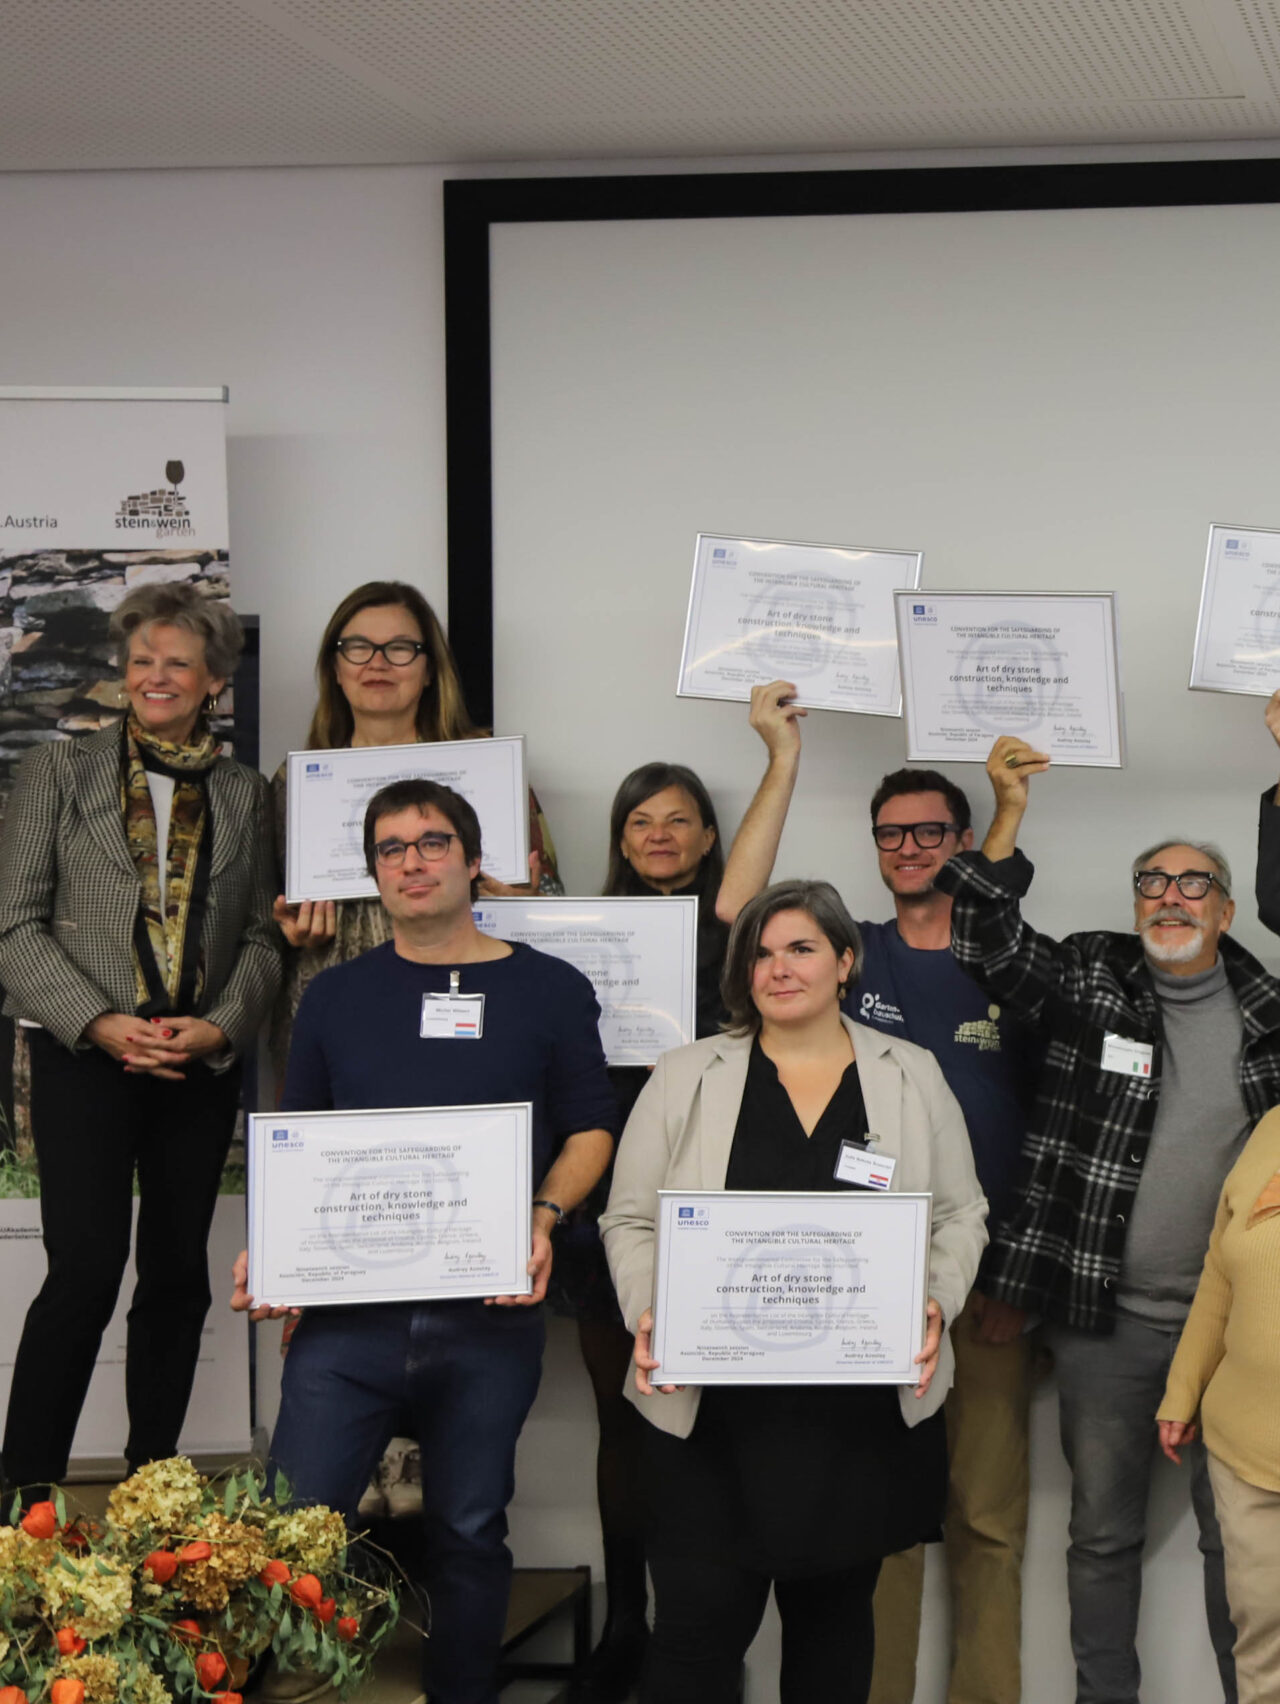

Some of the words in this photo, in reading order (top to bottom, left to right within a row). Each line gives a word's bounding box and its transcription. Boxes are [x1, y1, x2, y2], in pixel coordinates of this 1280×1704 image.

[767, 609, 781, 617] Art
[793, 611, 807, 622] dry
[809, 614, 833, 622] stone
[796, 620, 842, 633] knowledge
[976, 664, 989, 672] Art
[990, 665, 999, 673] of
[1001, 665, 1014, 675] dry
[949, 674, 1003, 684] construction,
[1006, 674, 1050, 685] knowledge
[1053, 676, 1068, 684] and
[986, 683, 1032, 694] techniques
[622, 978, 639, 986] and
[349, 1192, 366, 1201] Art
[369, 1191, 380, 1200] of
[382, 1190, 399, 1202] dry
[402, 1191, 432, 1199] stone
[314, 1202, 384, 1213] construction,
[387, 1199, 444, 1210] knowledge
[448, 1198, 467, 1207] and
[362, 1212, 420, 1221] techniques
[751, 1273, 767, 1282] Art
[770, 1273, 781, 1282] of
[783, 1273, 800, 1285] dry
[716, 1284, 784, 1294] construction,
[788, 1284, 843, 1295] knowledge
[846, 1284, 865, 1293] and
[762, 1294, 819, 1305] techniques
